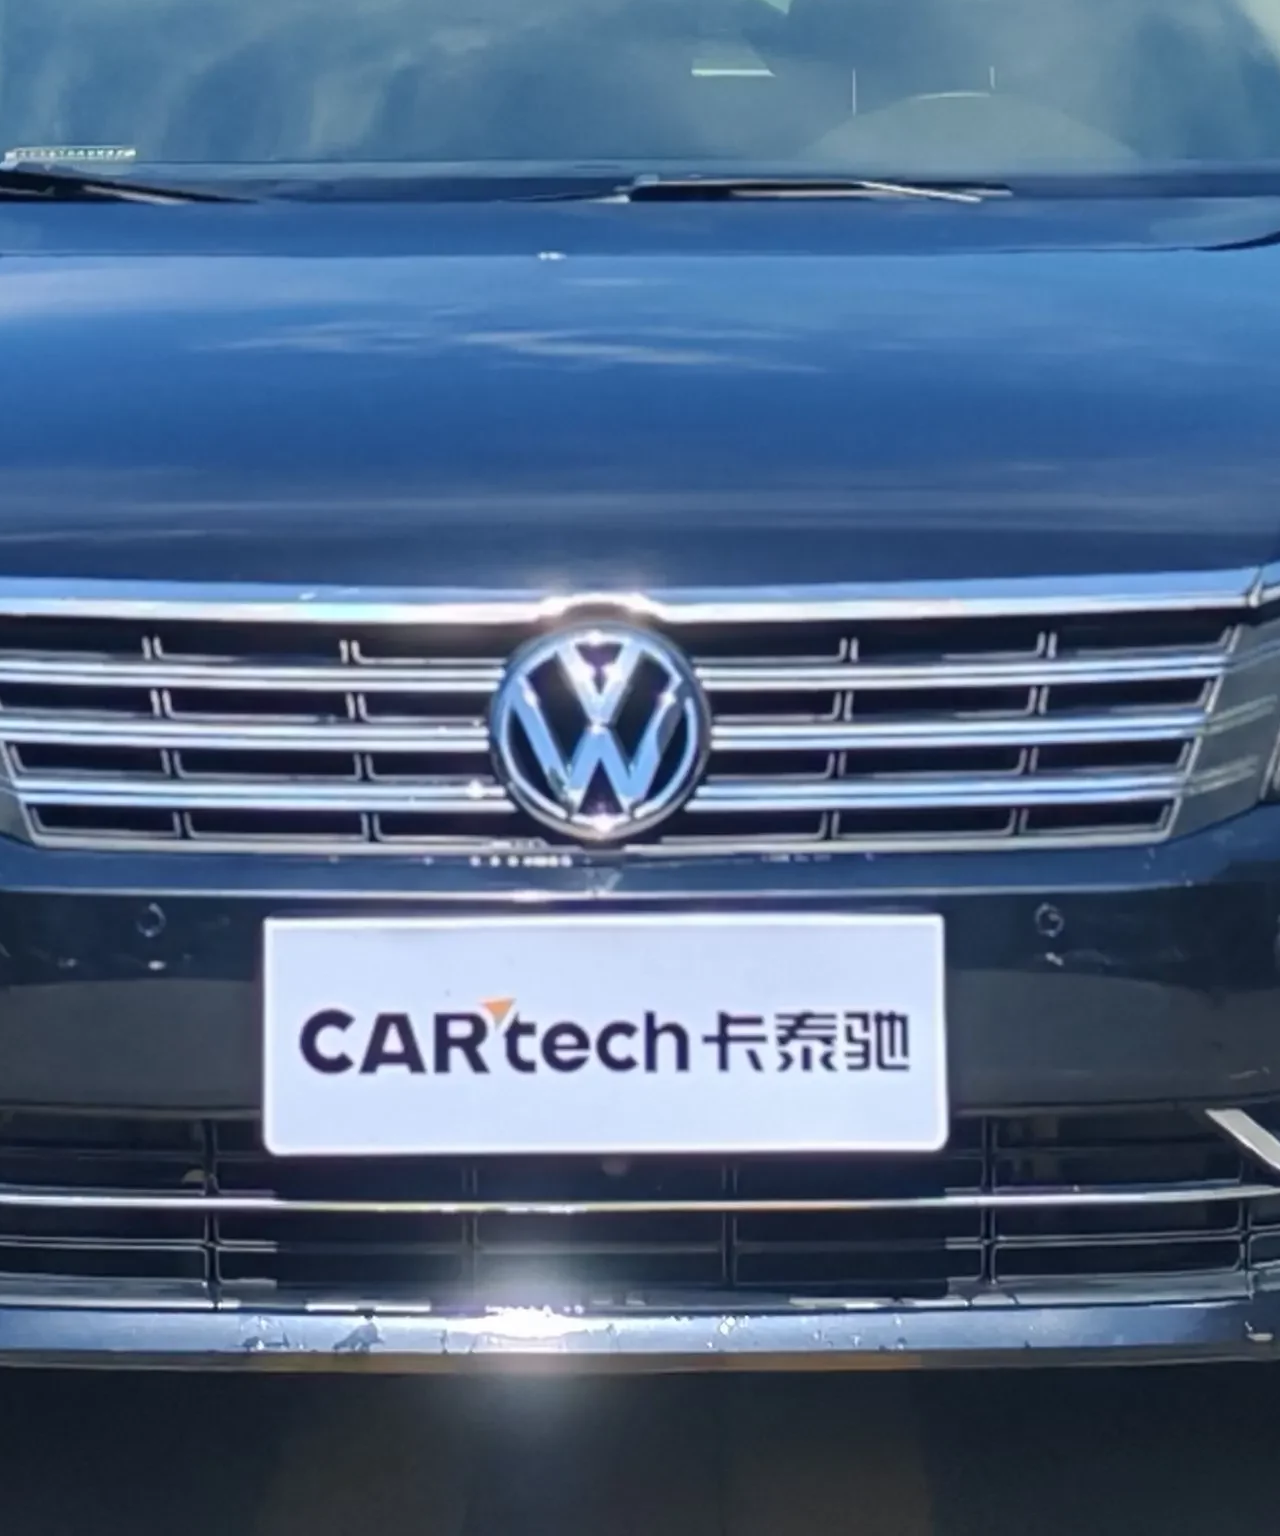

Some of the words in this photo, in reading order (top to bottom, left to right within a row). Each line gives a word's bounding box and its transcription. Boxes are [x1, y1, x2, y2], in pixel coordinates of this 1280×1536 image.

[299, 1006, 690, 1075] CARtech
[701, 1010, 912, 1073] 卡泰驰
